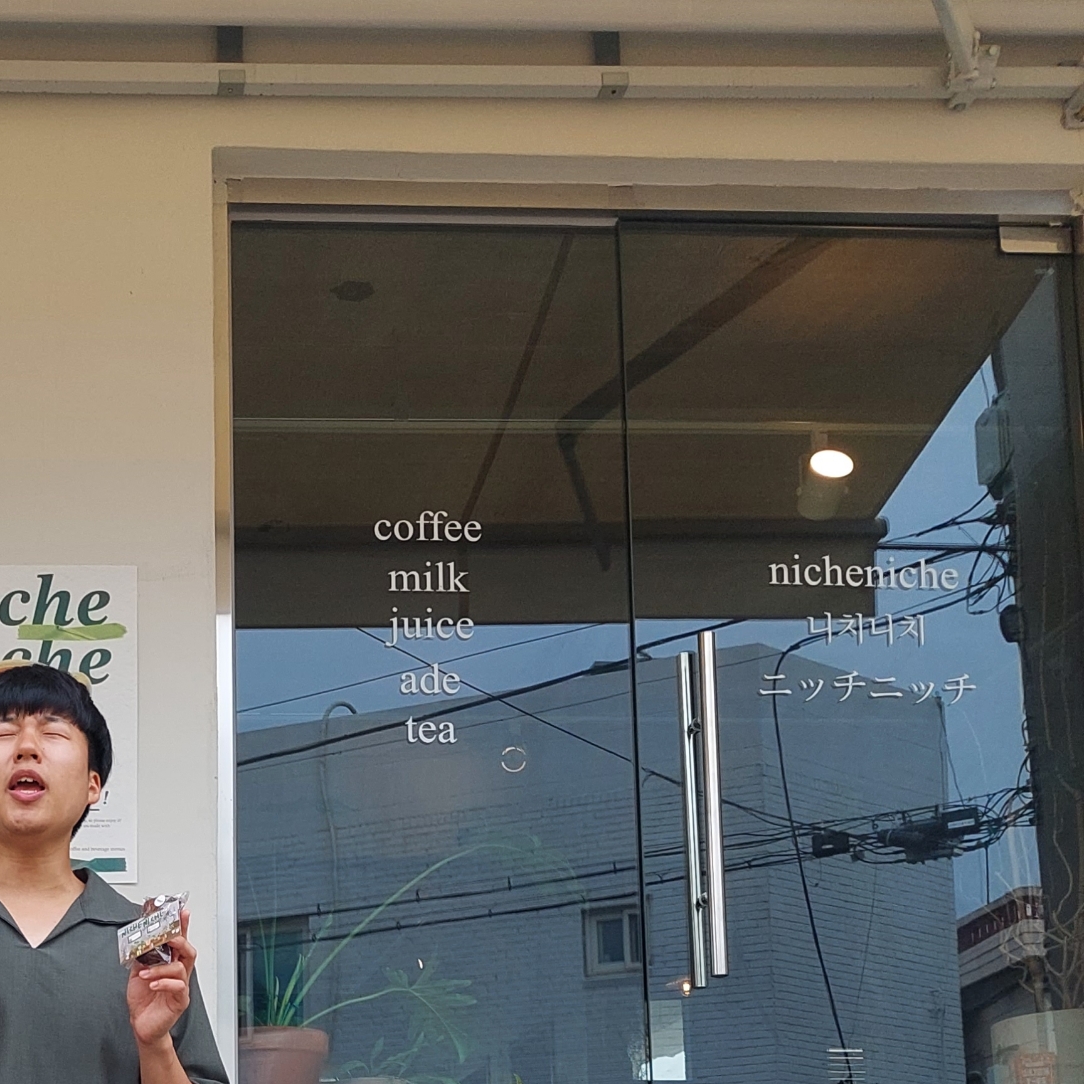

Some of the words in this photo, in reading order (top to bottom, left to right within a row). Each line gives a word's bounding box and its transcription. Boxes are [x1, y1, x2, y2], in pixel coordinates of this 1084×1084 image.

[374, 510, 482, 541] coffee
[388, 561, 470, 592] milk
[768, 554, 959, 589] nicheniche
[385, 606, 474, 646] juice
[806, 612, 925, 645] 니치니치
[399, 663, 461, 694] ade
[759, 671, 976, 704] ニッチニッチ
[405, 715, 457, 744] tea
